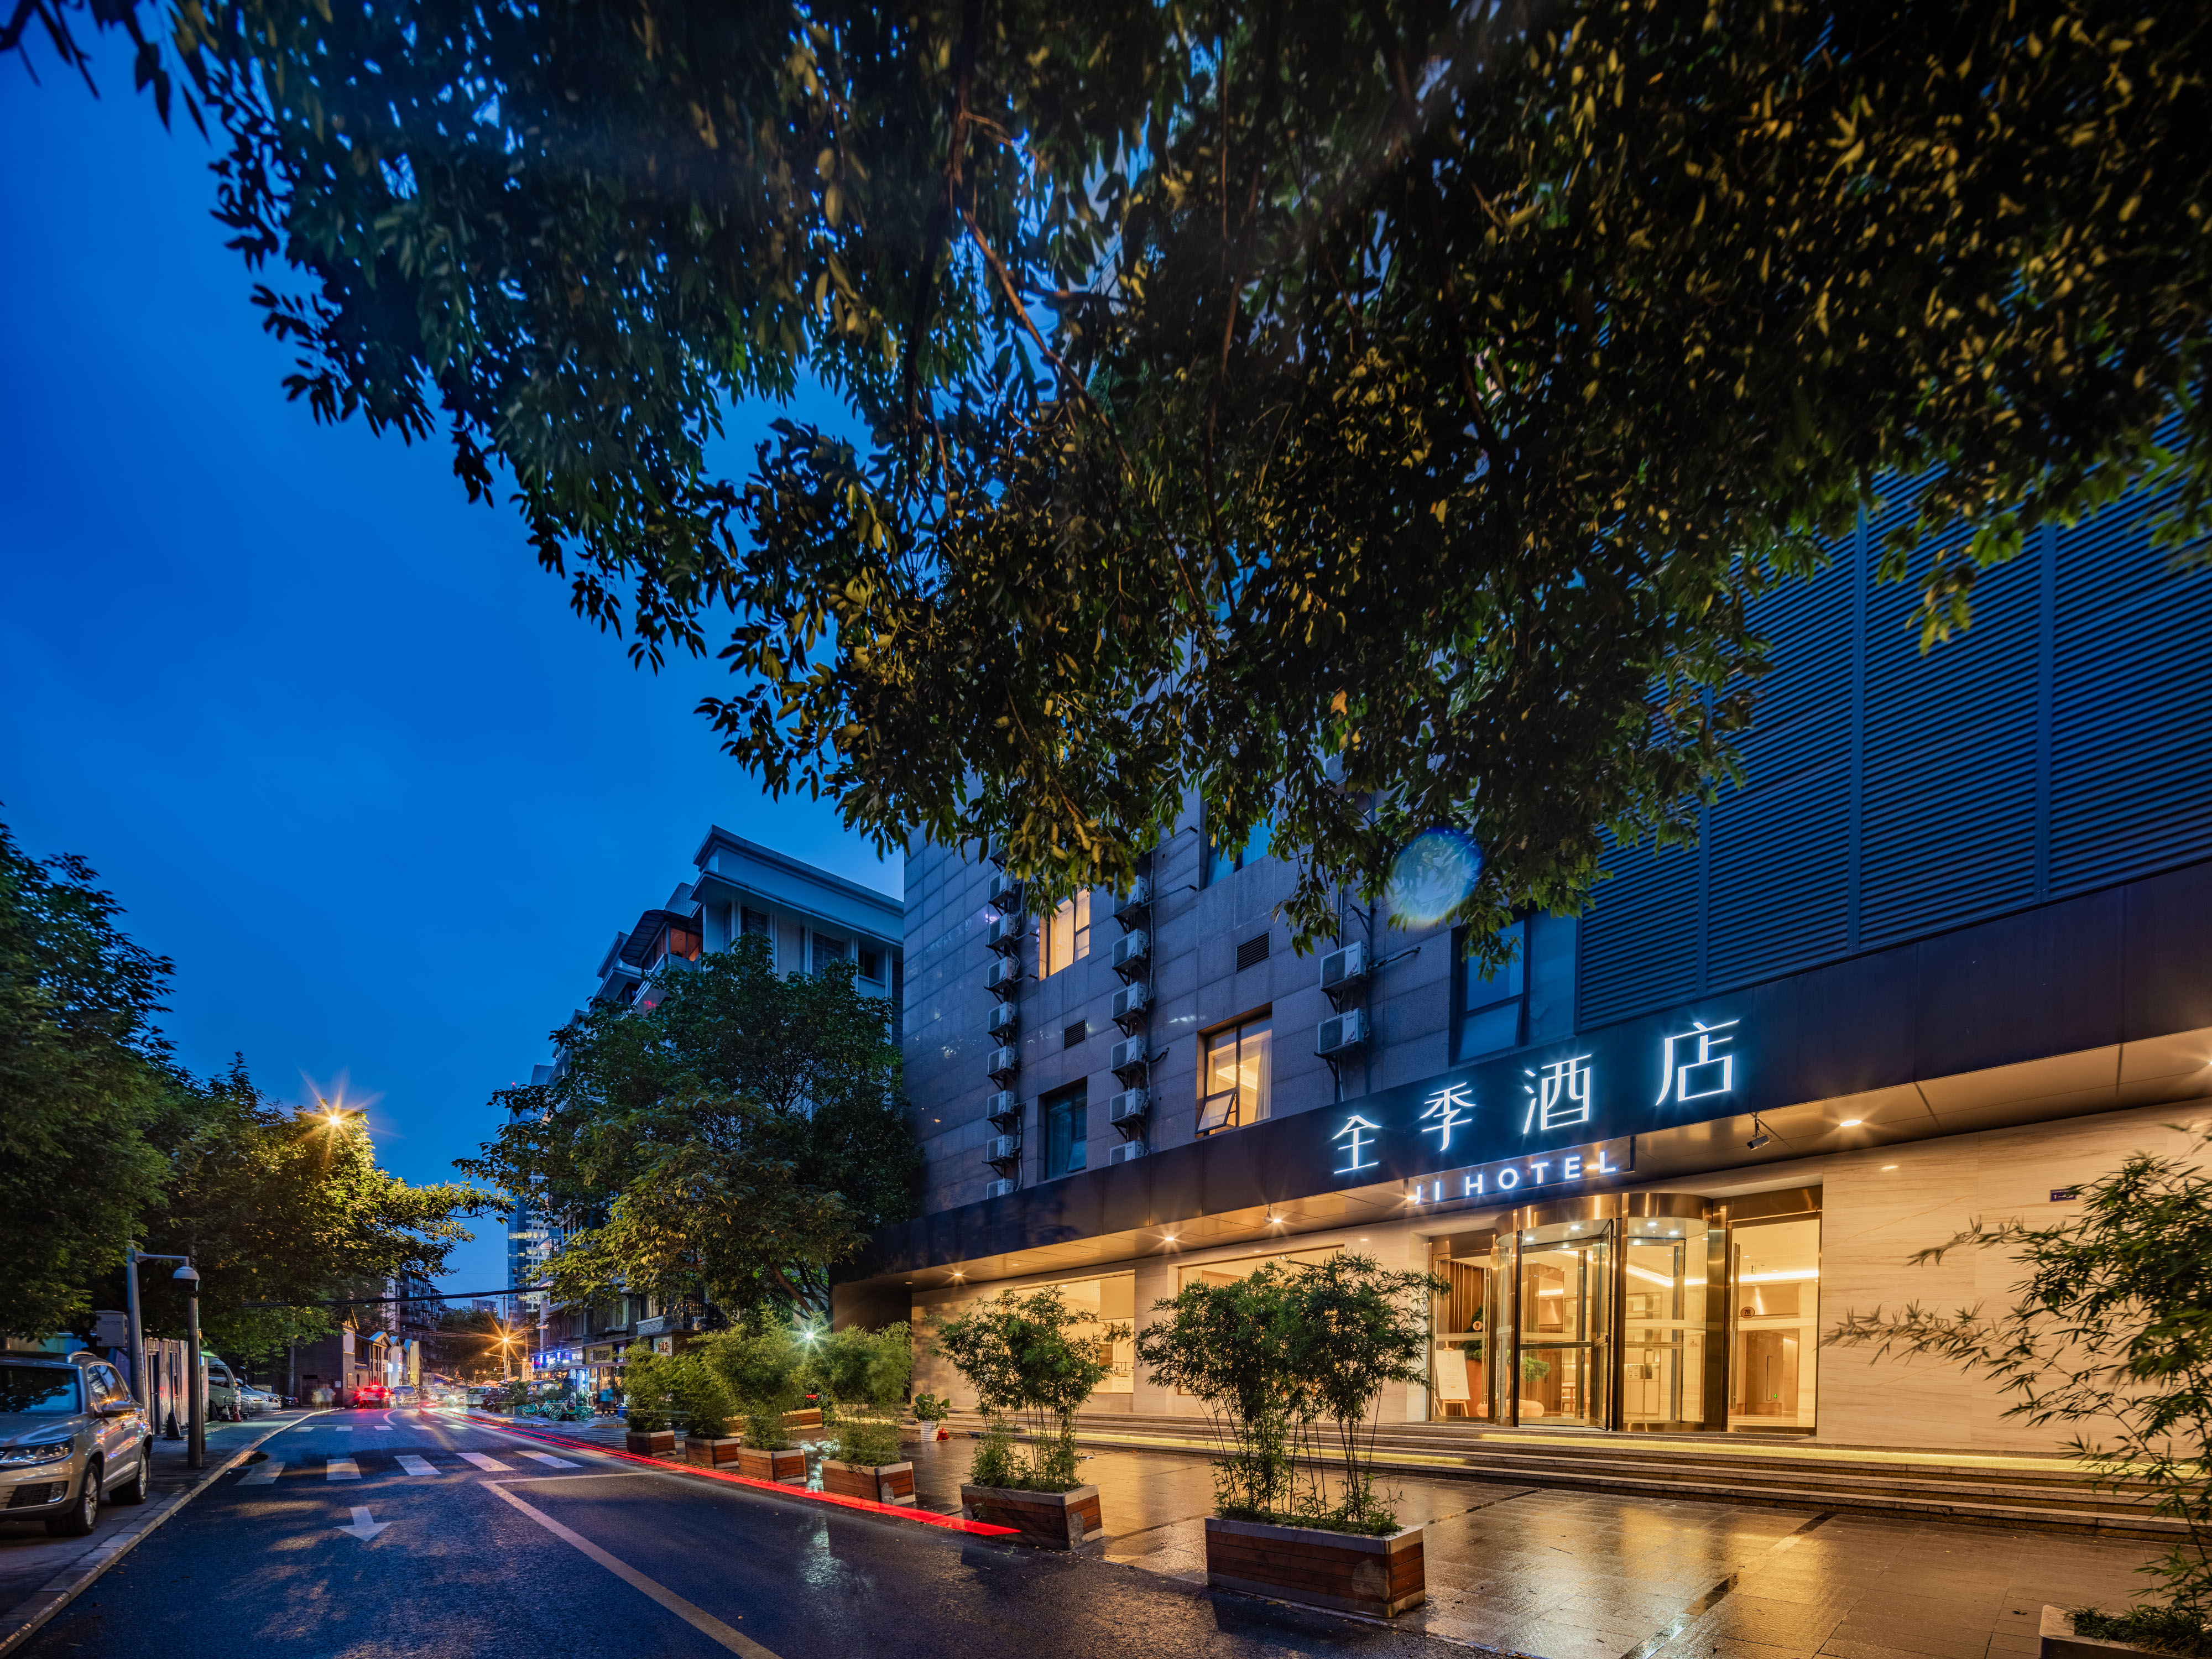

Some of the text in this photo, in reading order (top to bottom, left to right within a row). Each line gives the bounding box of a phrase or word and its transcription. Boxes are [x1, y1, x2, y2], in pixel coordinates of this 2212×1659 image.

[1332, 1020, 1740, 1174] 全季酒店
[1414, 1151, 1616, 1204] JI HOTEL
